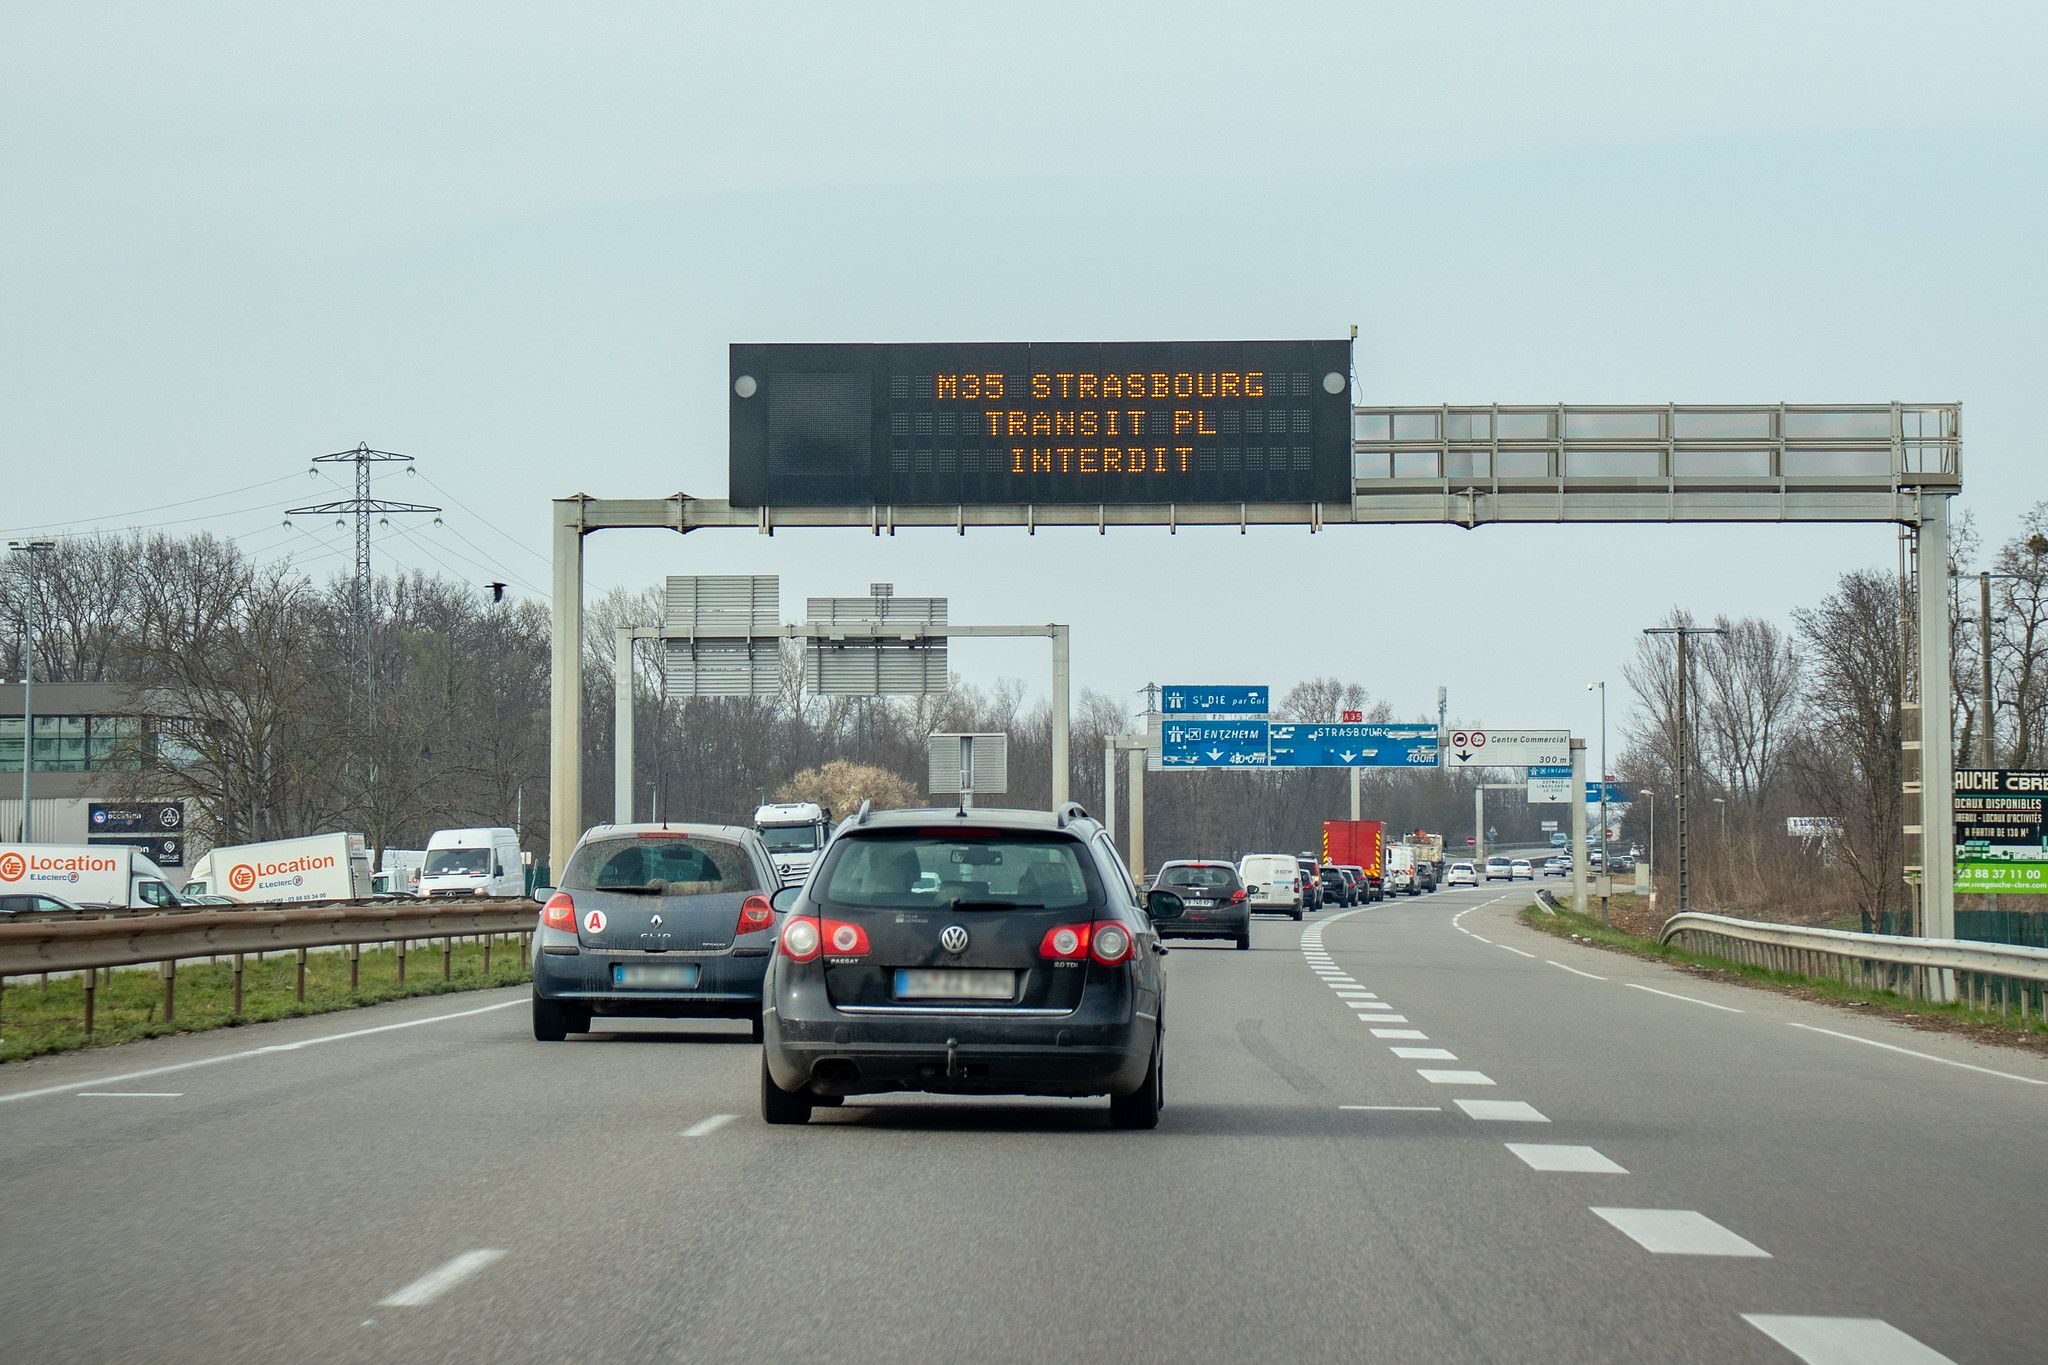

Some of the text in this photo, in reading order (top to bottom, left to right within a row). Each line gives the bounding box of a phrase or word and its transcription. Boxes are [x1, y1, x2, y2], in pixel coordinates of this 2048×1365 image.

[937, 372, 1265, 400] M35 STRASBOURG
[985, 409, 1217, 436] TRANSIT PL
[1011, 447, 1194, 473] INTERDIT
[1208, 695, 1226, 705] DIE
[1250, 697, 1265, 705] Col
[1203, 730, 1259, 740] ENTZHEIM
[1317, 727, 1391, 737] STRASBOURG
[1491, 736, 1518, 744] Centre
[1520, 735, 1567, 744] Commercial
[1539, 755, 1558, 764] 300
[1955, 771, 1999, 790] AUCHE
[1955, 798, 2042, 810] OCAUX DISPONIBLES
[1983, 813, 2005, 823] LOCAUX
[1996, 828, 2005, 837] DE
[2007, 828, 2019, 838] 130
[30, 854, 116, 872] Location
[257, 855, 335, 877] Location
[30, 873, 67, 881] E.Leclerc
[1975, 869, 1989, 879] 88
[1992, 869, 2006, 879] 37
[2010, 869, 2022, 879] 11
[2026, 869, 2041, 879] 00
[258, 879, 293, 889] E.Leclerc
[588, 912, 601, 930] A
